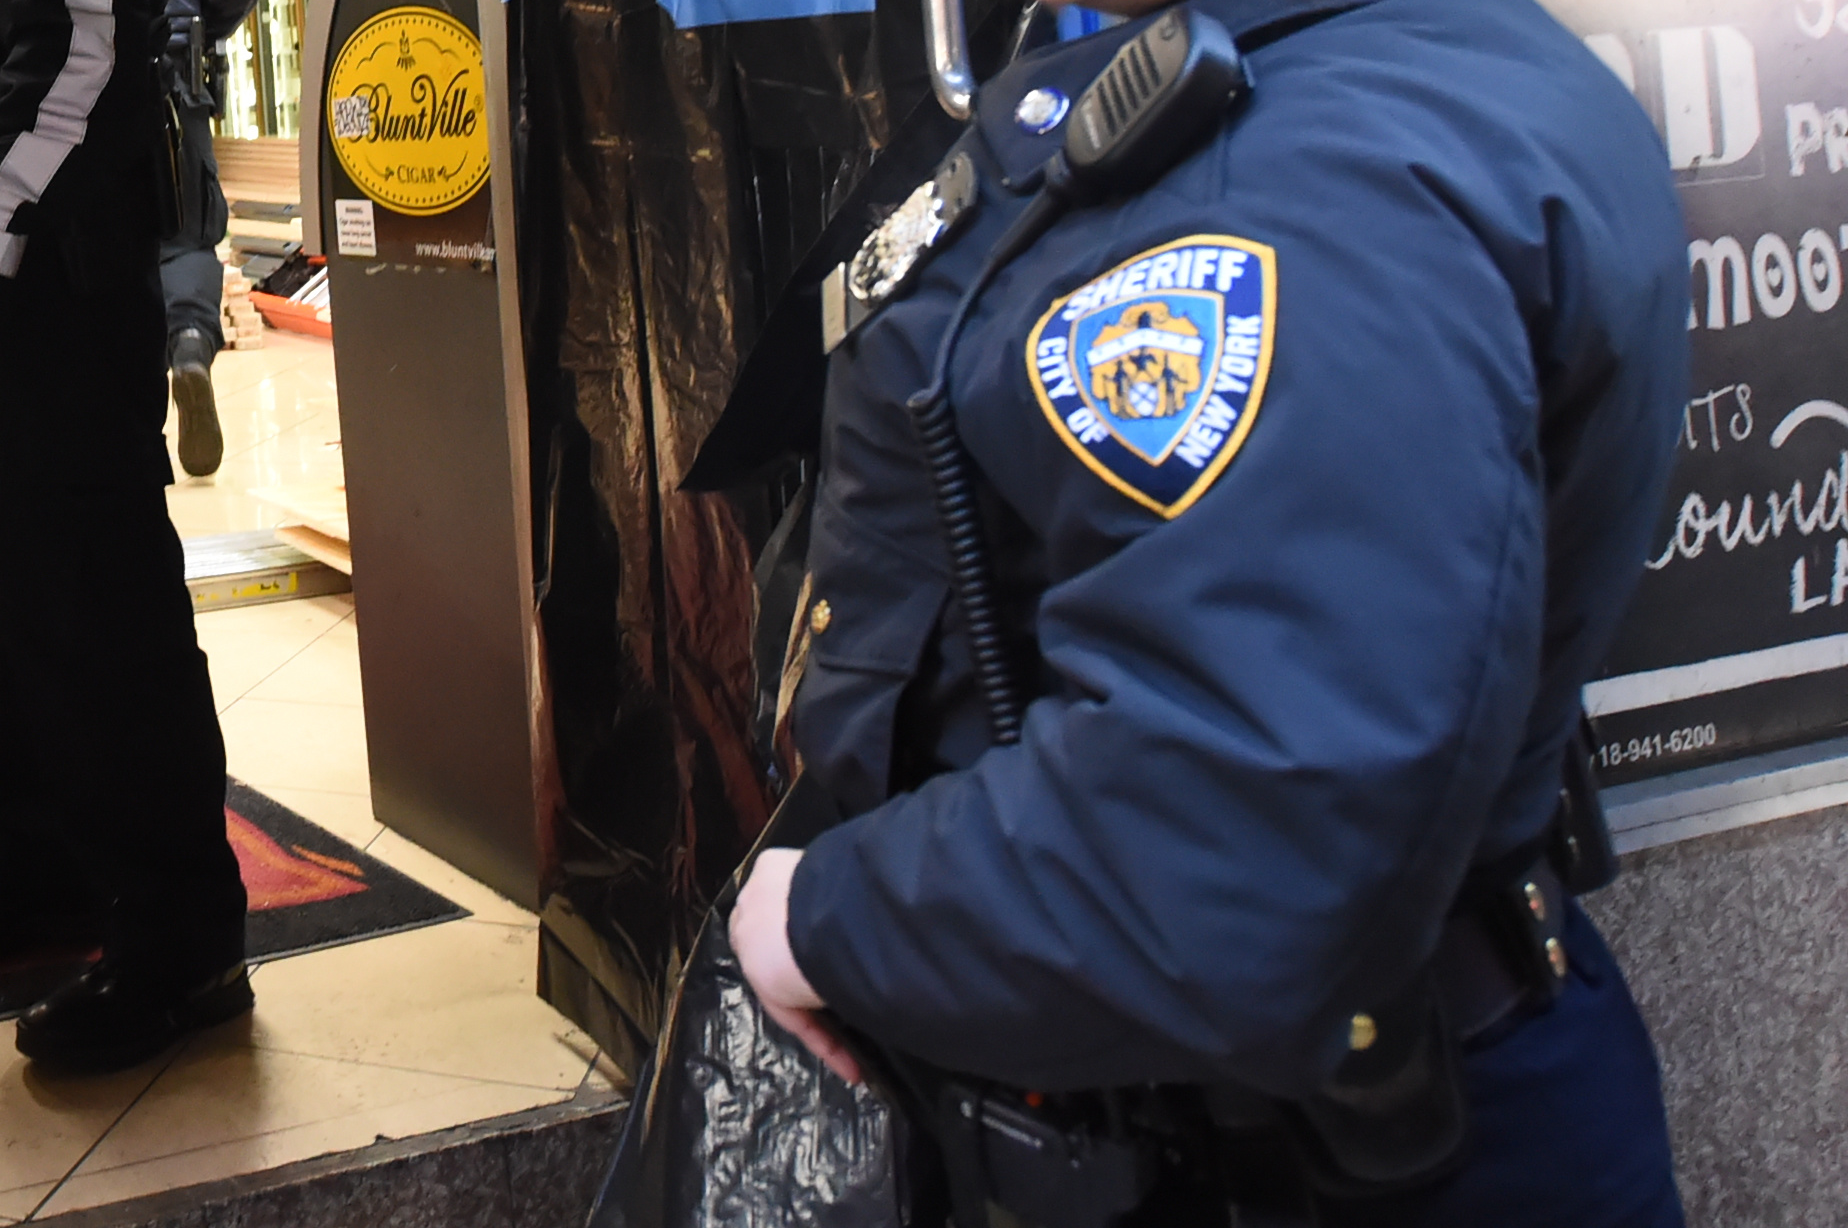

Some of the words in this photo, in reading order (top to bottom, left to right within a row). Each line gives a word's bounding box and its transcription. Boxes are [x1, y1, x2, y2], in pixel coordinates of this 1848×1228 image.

[395, 163, 438, 188] CIGAR
[1061, 247, 1248, 322] SHERIFF
[1686, 222, 1848, 331] moo
[1036, 335, 1078, 400] CITY
[1066, 406, 1110, 445] OF
[1174, 393, 1238, 469] NEW
[1213, 314, 1263, 394] YORK
[1589, 722, 1718, 770] 18-941-6200
